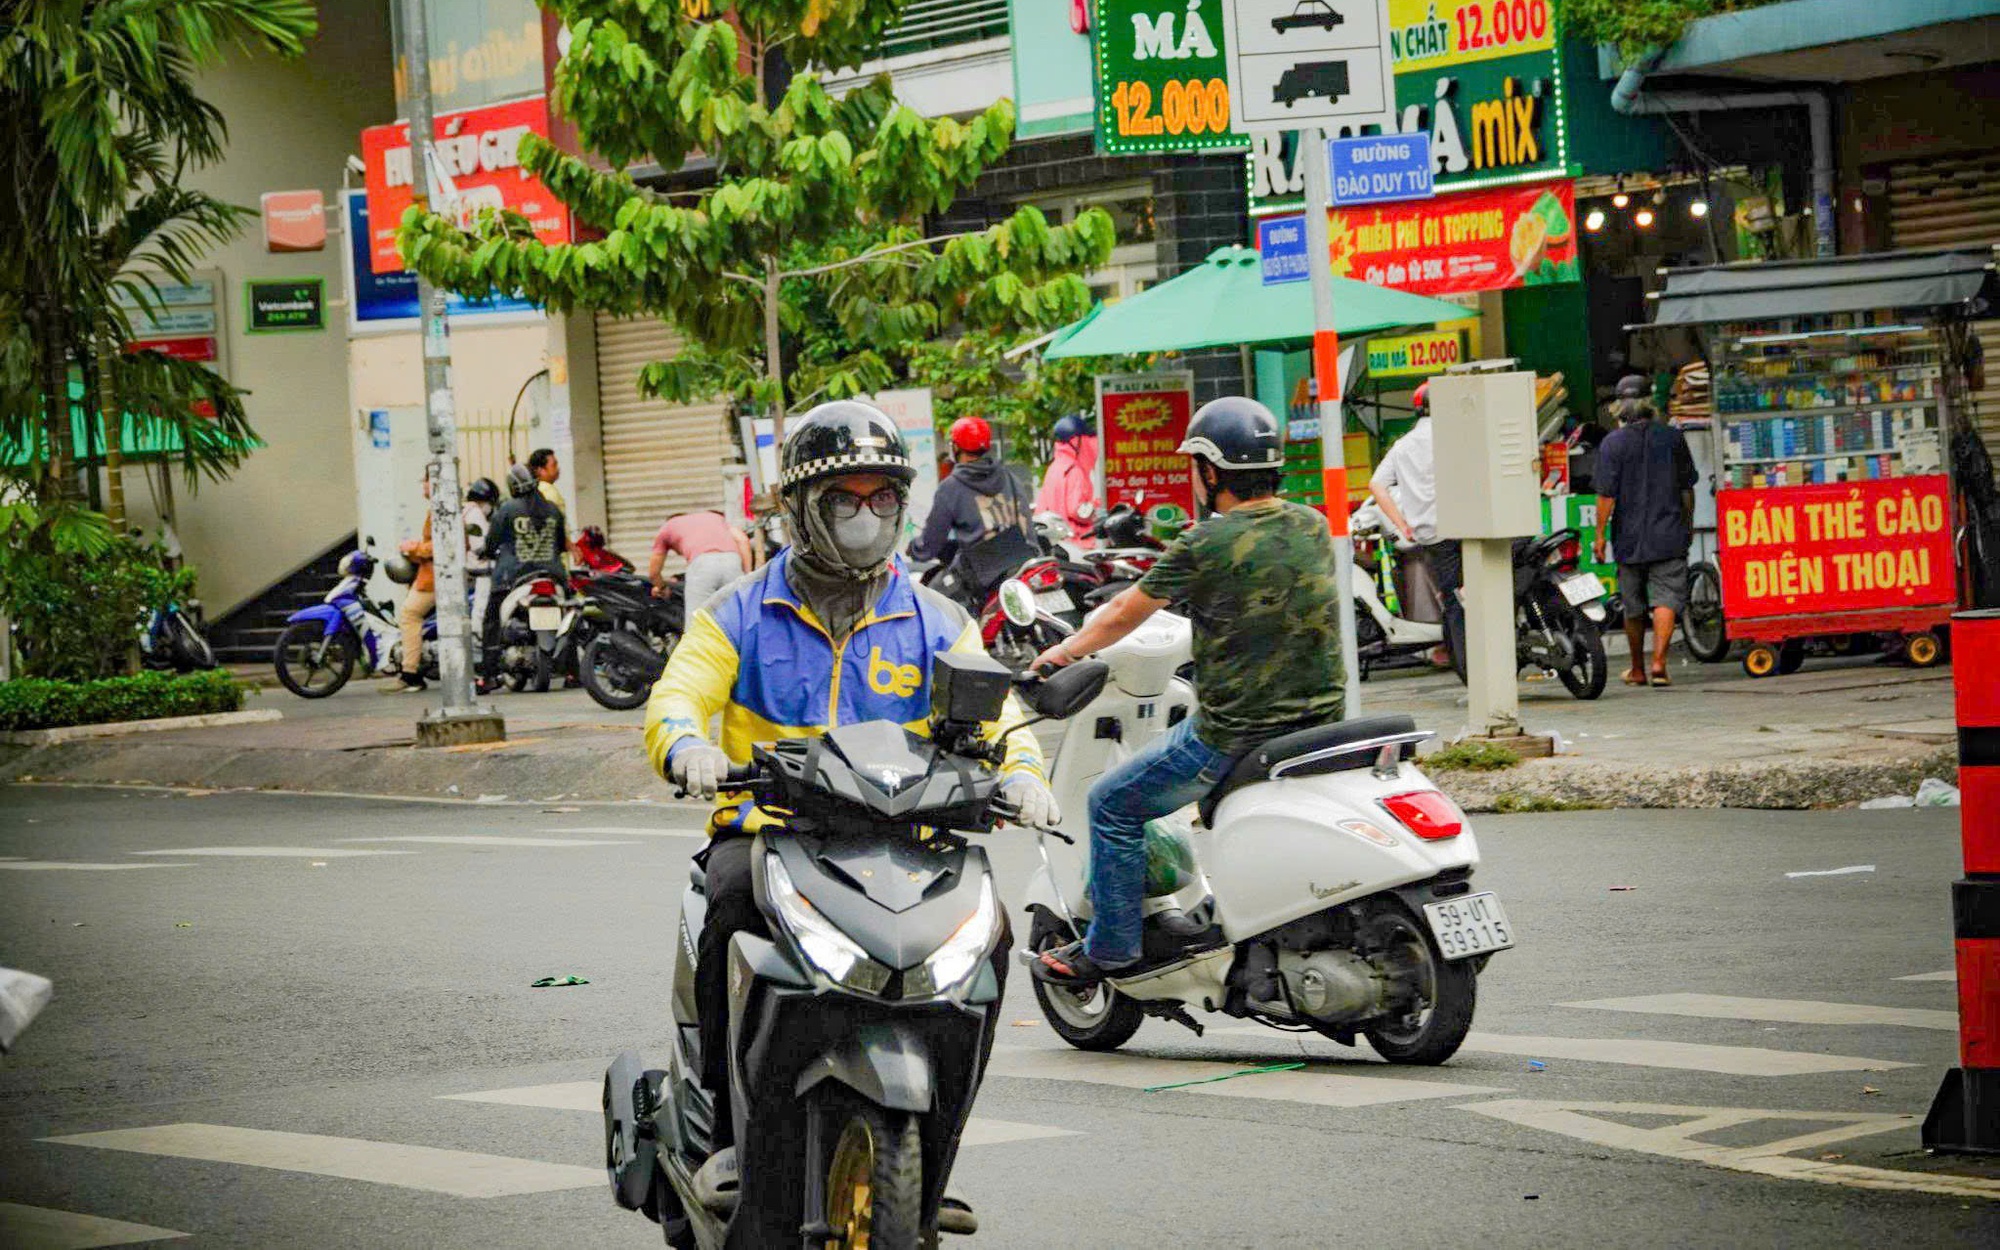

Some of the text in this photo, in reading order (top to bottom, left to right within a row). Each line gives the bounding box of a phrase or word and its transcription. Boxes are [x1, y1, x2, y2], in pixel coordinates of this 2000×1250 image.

[1130, 0, 1218, 60] MÁ
[1405, 4, 1448, 57] CHẤT
[1456, 0, 1547, 51] 12.000
[1111, 78, 1230, 137] 12.000
[1471, 76, 1538, 170] mix
[1336, 163, 1429, 198] ĐÀO DUY TỪ
[1351, 142, 1411, 164] ĐƯỜNG
[1396, 212, 1420, 250] PHÍ
[1443, 208, 1504, 244] TOPPING
[1409, 339, 1458, 367] 12.000
[1726, 487, 1943, 548] BÁN THẺ CÀO
[1745, 548, 1932, 604] ĐIỆN THOẠI
[868, 646, 922, 697] be
